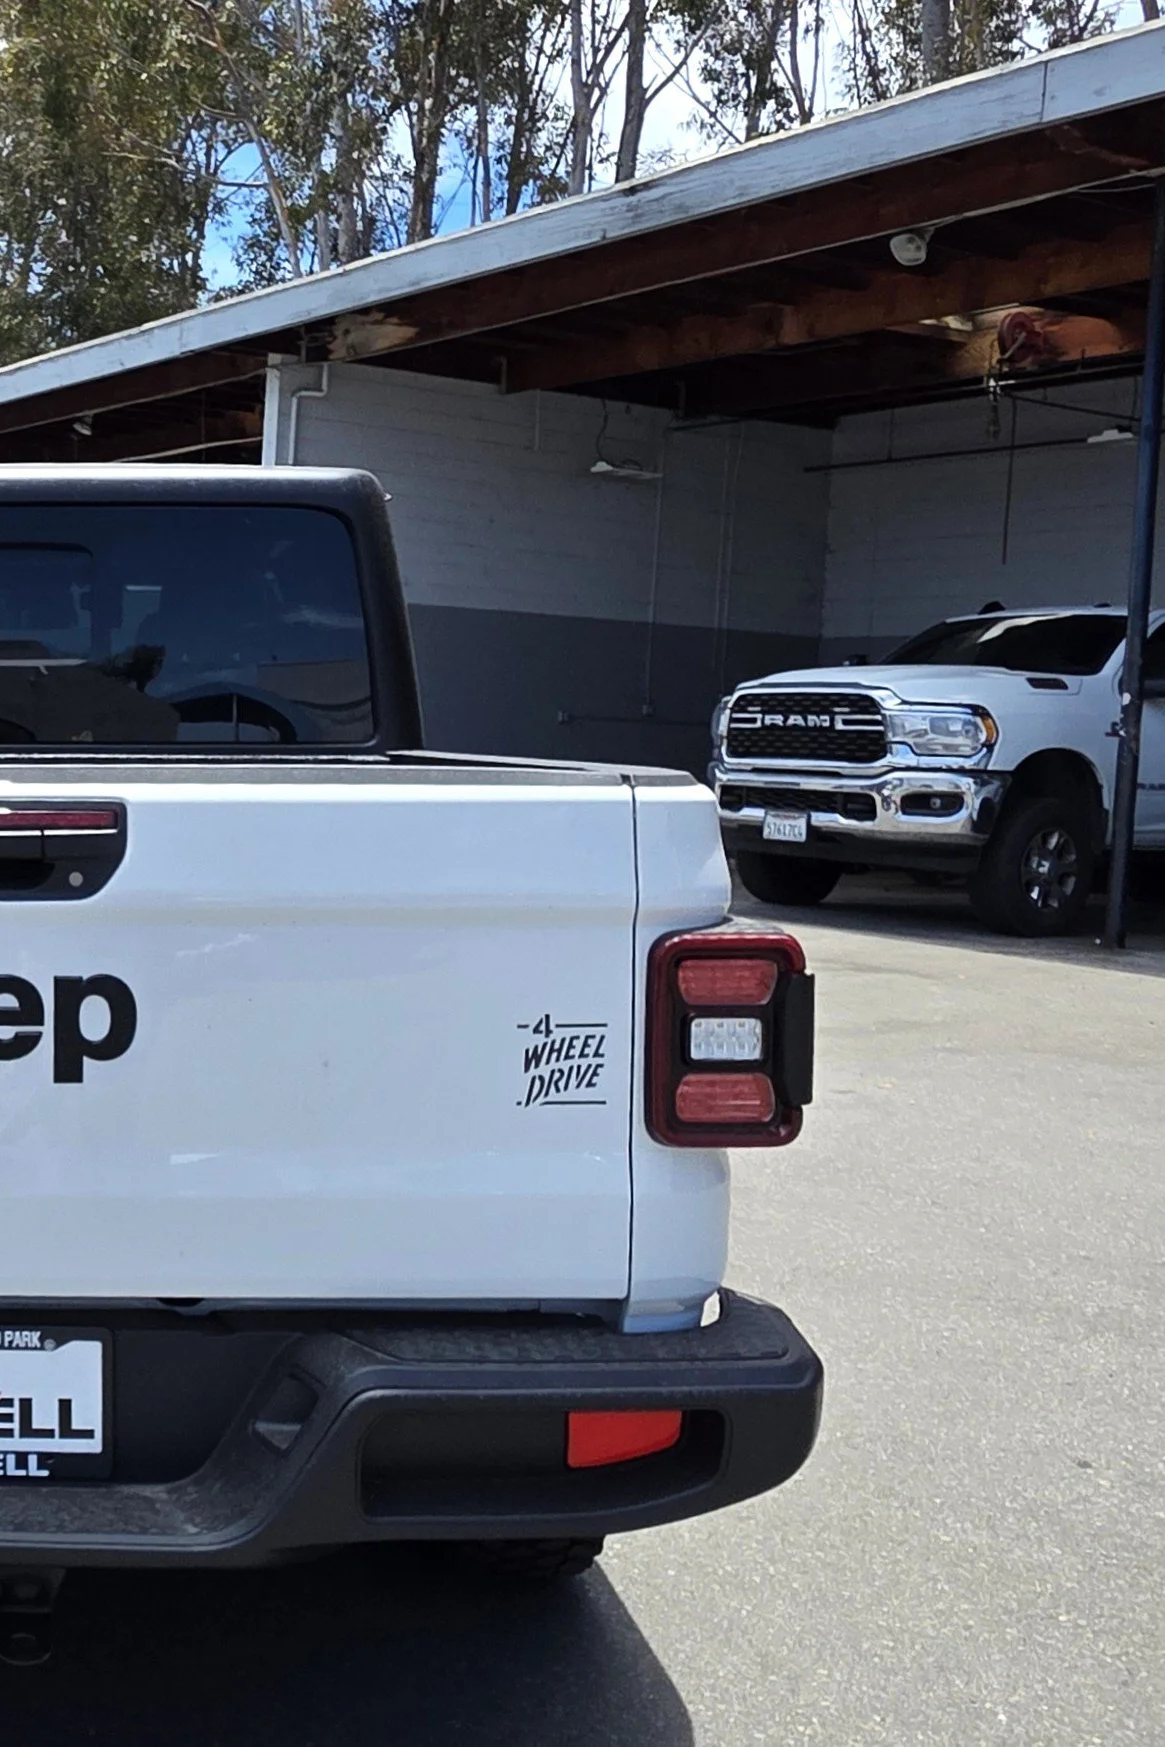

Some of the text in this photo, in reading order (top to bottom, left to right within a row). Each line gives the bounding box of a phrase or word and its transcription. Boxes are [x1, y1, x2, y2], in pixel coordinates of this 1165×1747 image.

[764, 714, 830, 727] RAM
[532, 1013, 554, 1038] 4
[523, 1034, 606, 1074] WHEEL
[524, 1063, 605, 1108] DRIVE
[4, 1330, 42, 1348] PARK
